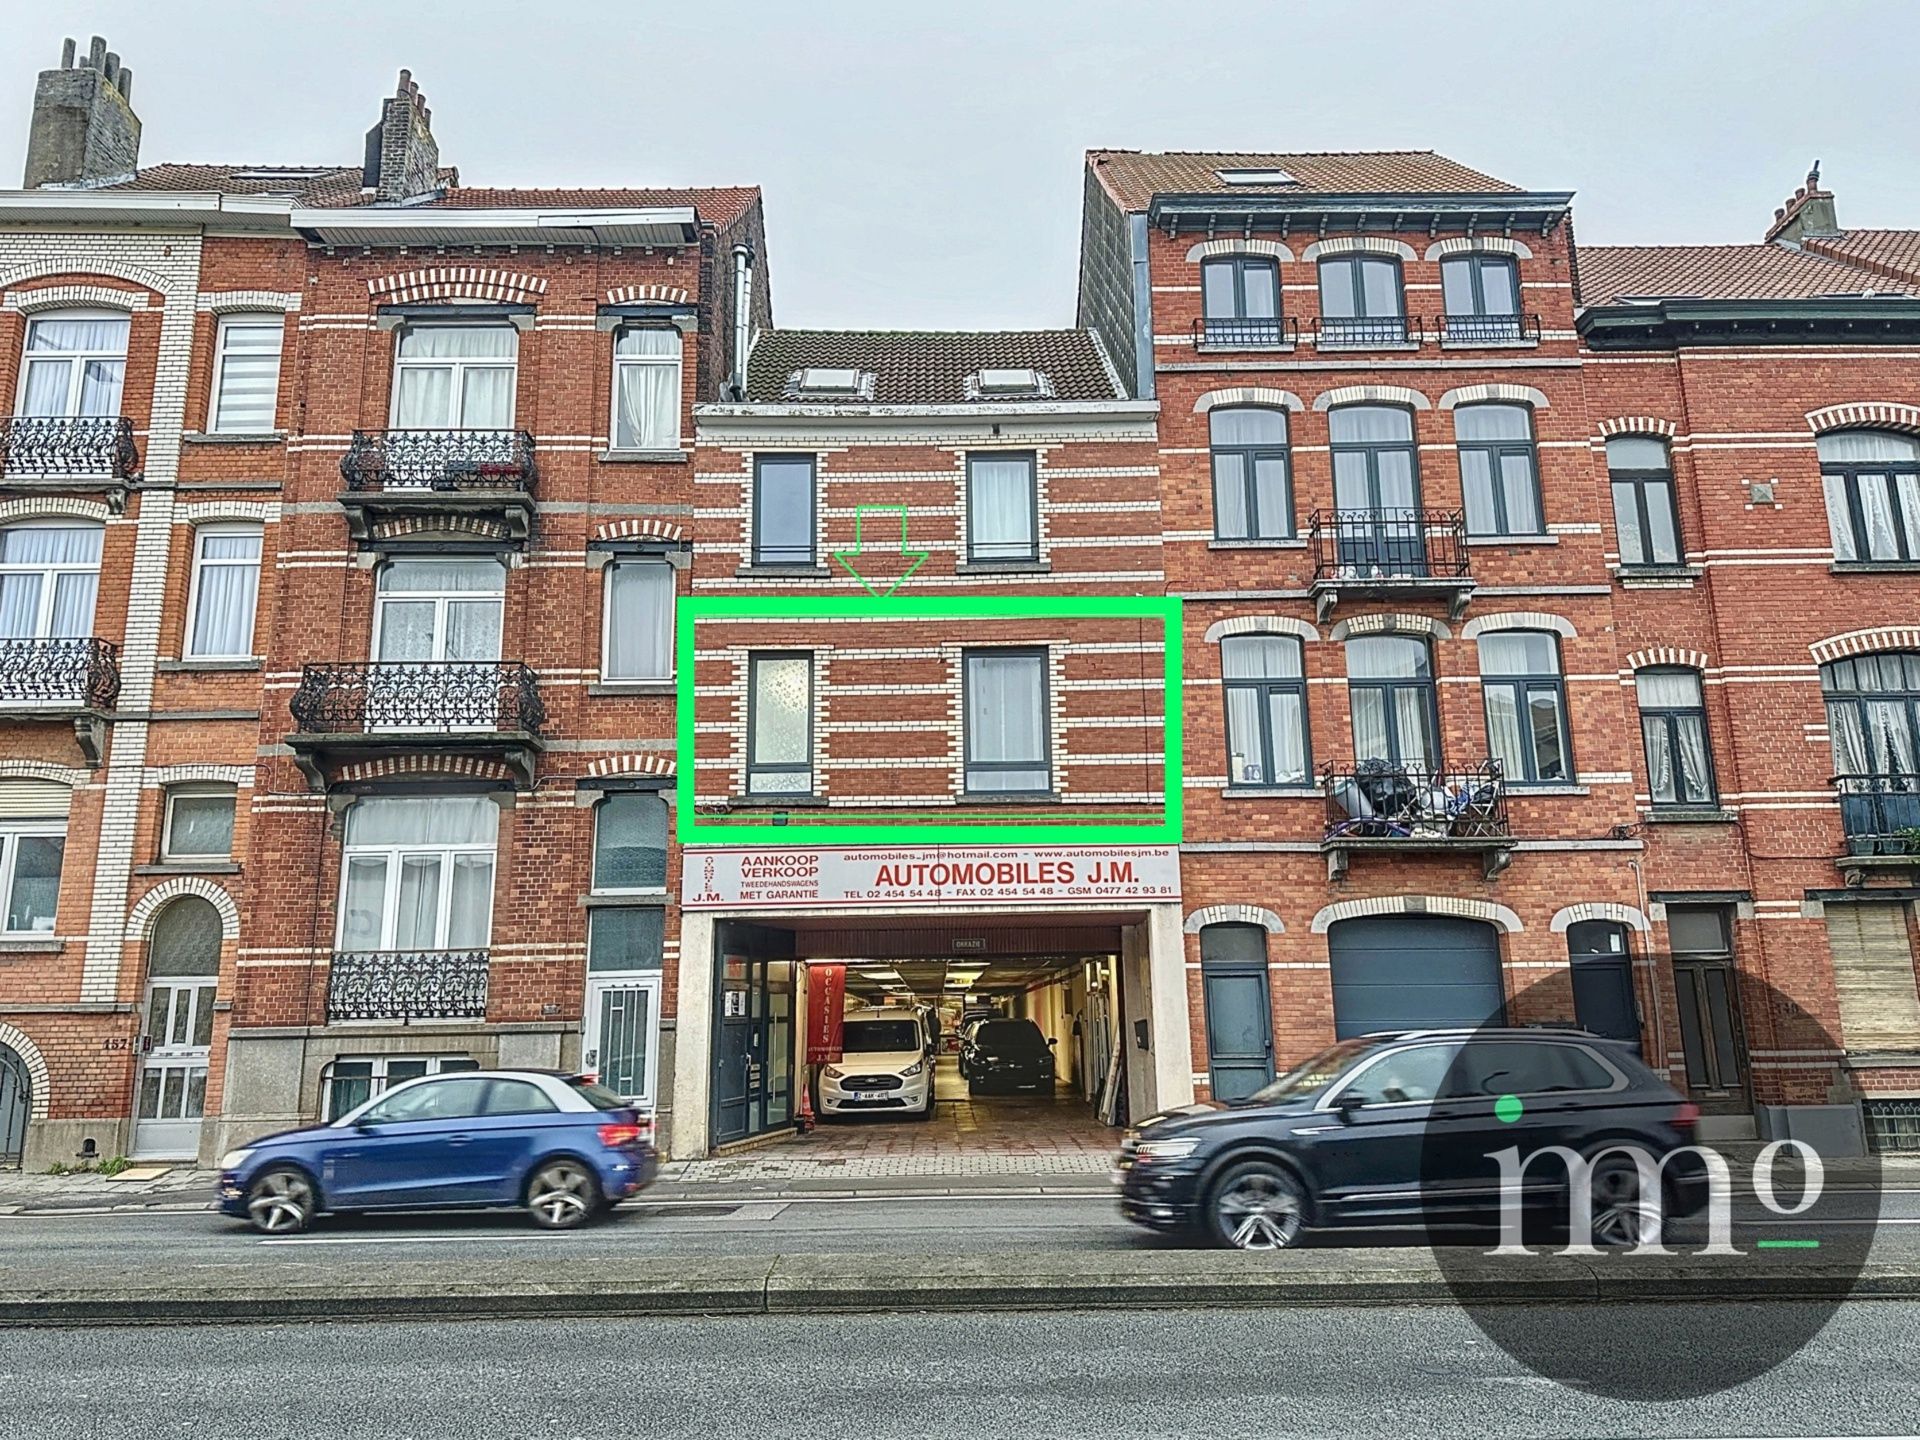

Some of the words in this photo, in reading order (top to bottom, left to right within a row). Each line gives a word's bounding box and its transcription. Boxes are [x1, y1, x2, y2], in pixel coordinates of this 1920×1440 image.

[741, 855, 819, 867] AANKOOP
[843, 850, 1018, 861] automobiles_jm@hotmail.com
[1034, 849, 1169, 858] www.automobilesjm.be
[741, 866, 819, 878] VERKOOP
[875, 861, 1075, 887] AUTOMOBILES
[1087, 861, 1140, 884] J.M.
[741, 879, 819, 888] TWEEDEHANDSWAGENS
[692, 893, 724, 902] J.M.
[740, 891, 763, 900] MET
[766, 889, 818, 899] GARANTIE
[844, 890, 863, 899] TEL
[866, 890, 881, 898] 02
[884, 889, 905, 898] 454
[909, 889, 923, 898] 54
[927, 888, 942, 897] 48
[956, 888, 976, 896] FAX
[980, 887, 994, 896] 02
[997, 887, 1018, 896] 454
[1022, 887, 1036, 895] 54
[1039, 887, 1054, 895] 48
[1067, 886, 1092, 895] GSM
[1095, 886, 1121, 895] 0477
[1125, 886, 1138, 894] 42
[1142, 886, 1156, 894] 93
[1160, 886, 1172, 894] 81
[822, 968, 832, 1044] OCCASIES
[103, 1038, 128, 1050] 157
